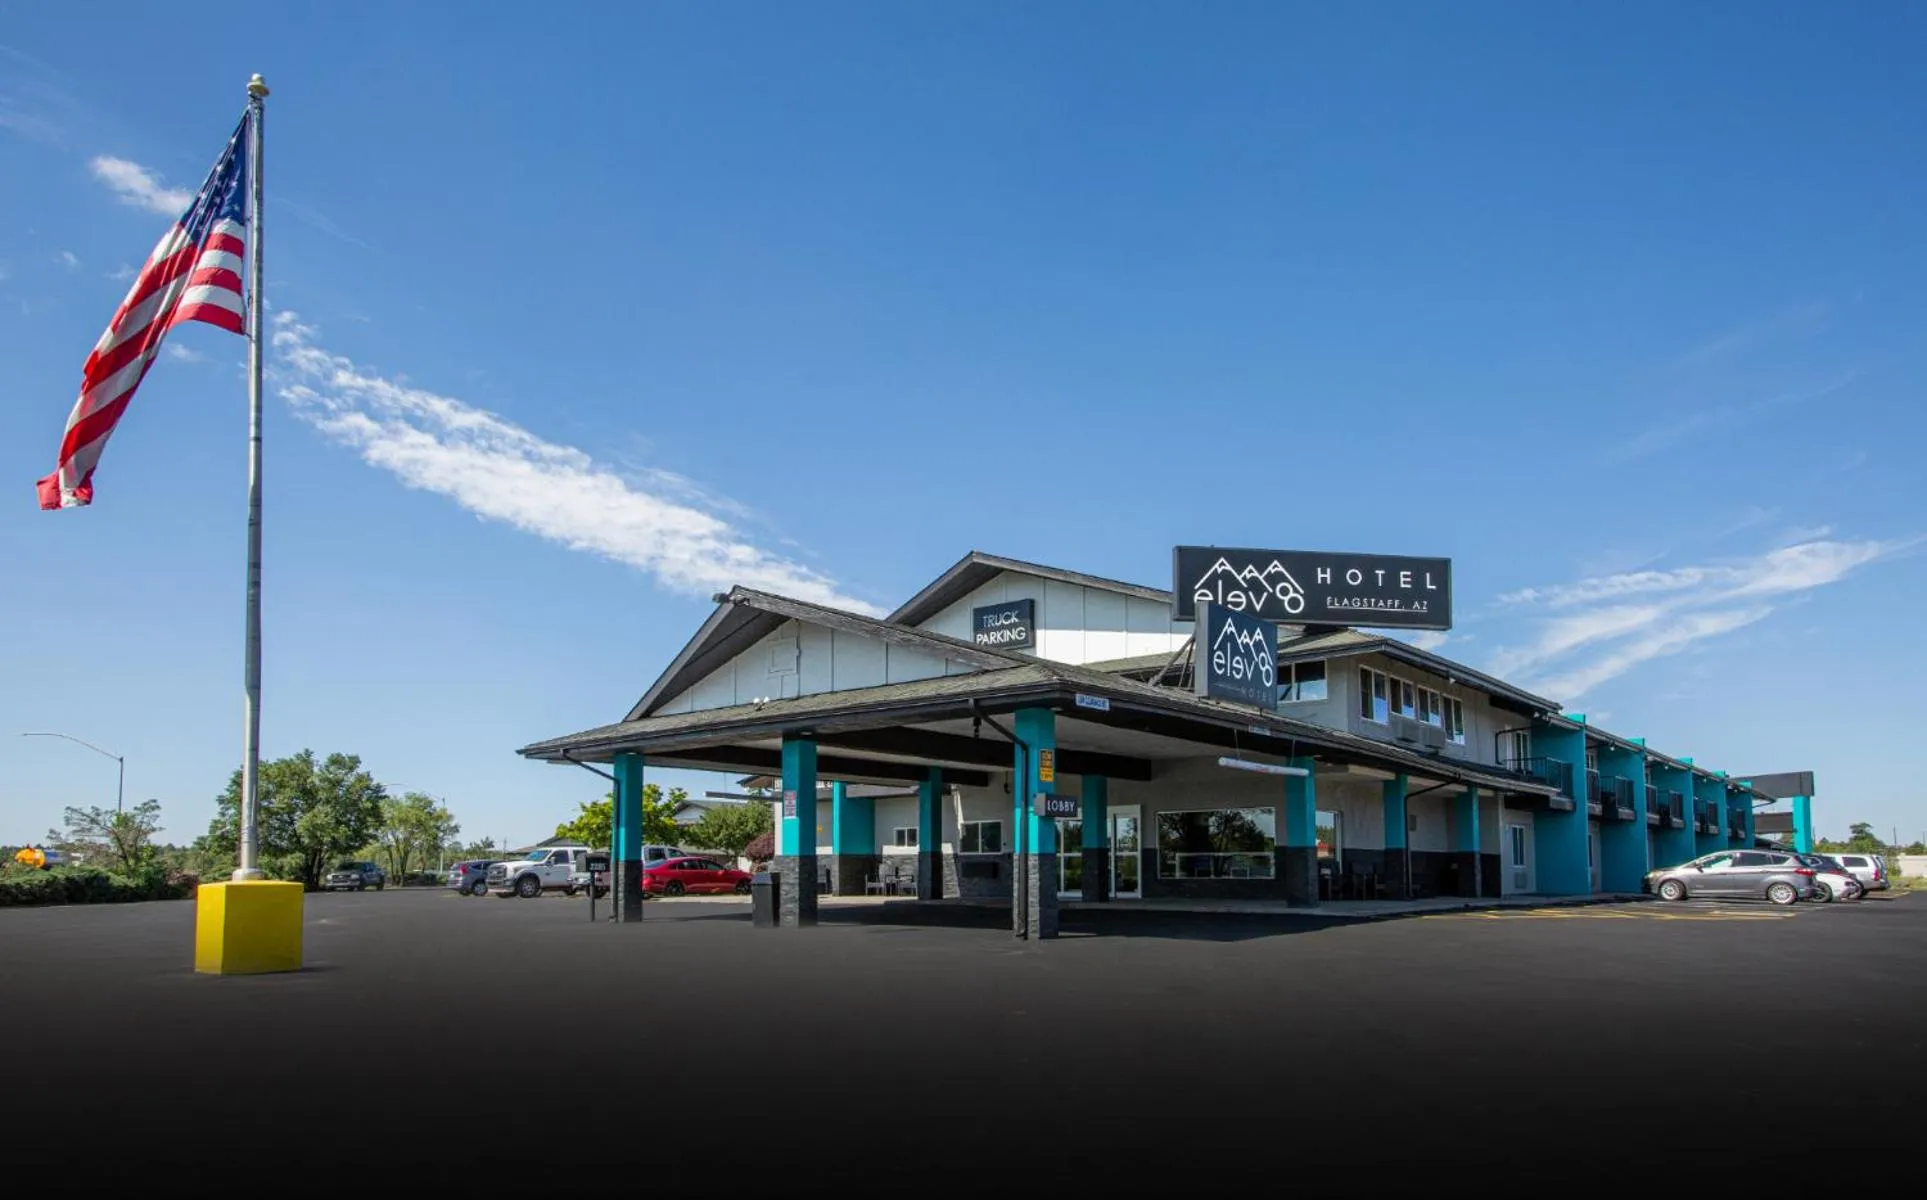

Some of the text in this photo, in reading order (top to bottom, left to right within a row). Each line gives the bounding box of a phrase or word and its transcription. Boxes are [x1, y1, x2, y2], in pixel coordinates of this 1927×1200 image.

[1316, 567, 1437, 590] HOTEL
[1412, 600, 1428, 610] AZ
[982, 610, 1019, 628] TRUCK
[975, 626, 1026, 645] PARKING
[1047, 800, 1075, 812] LOBBY
